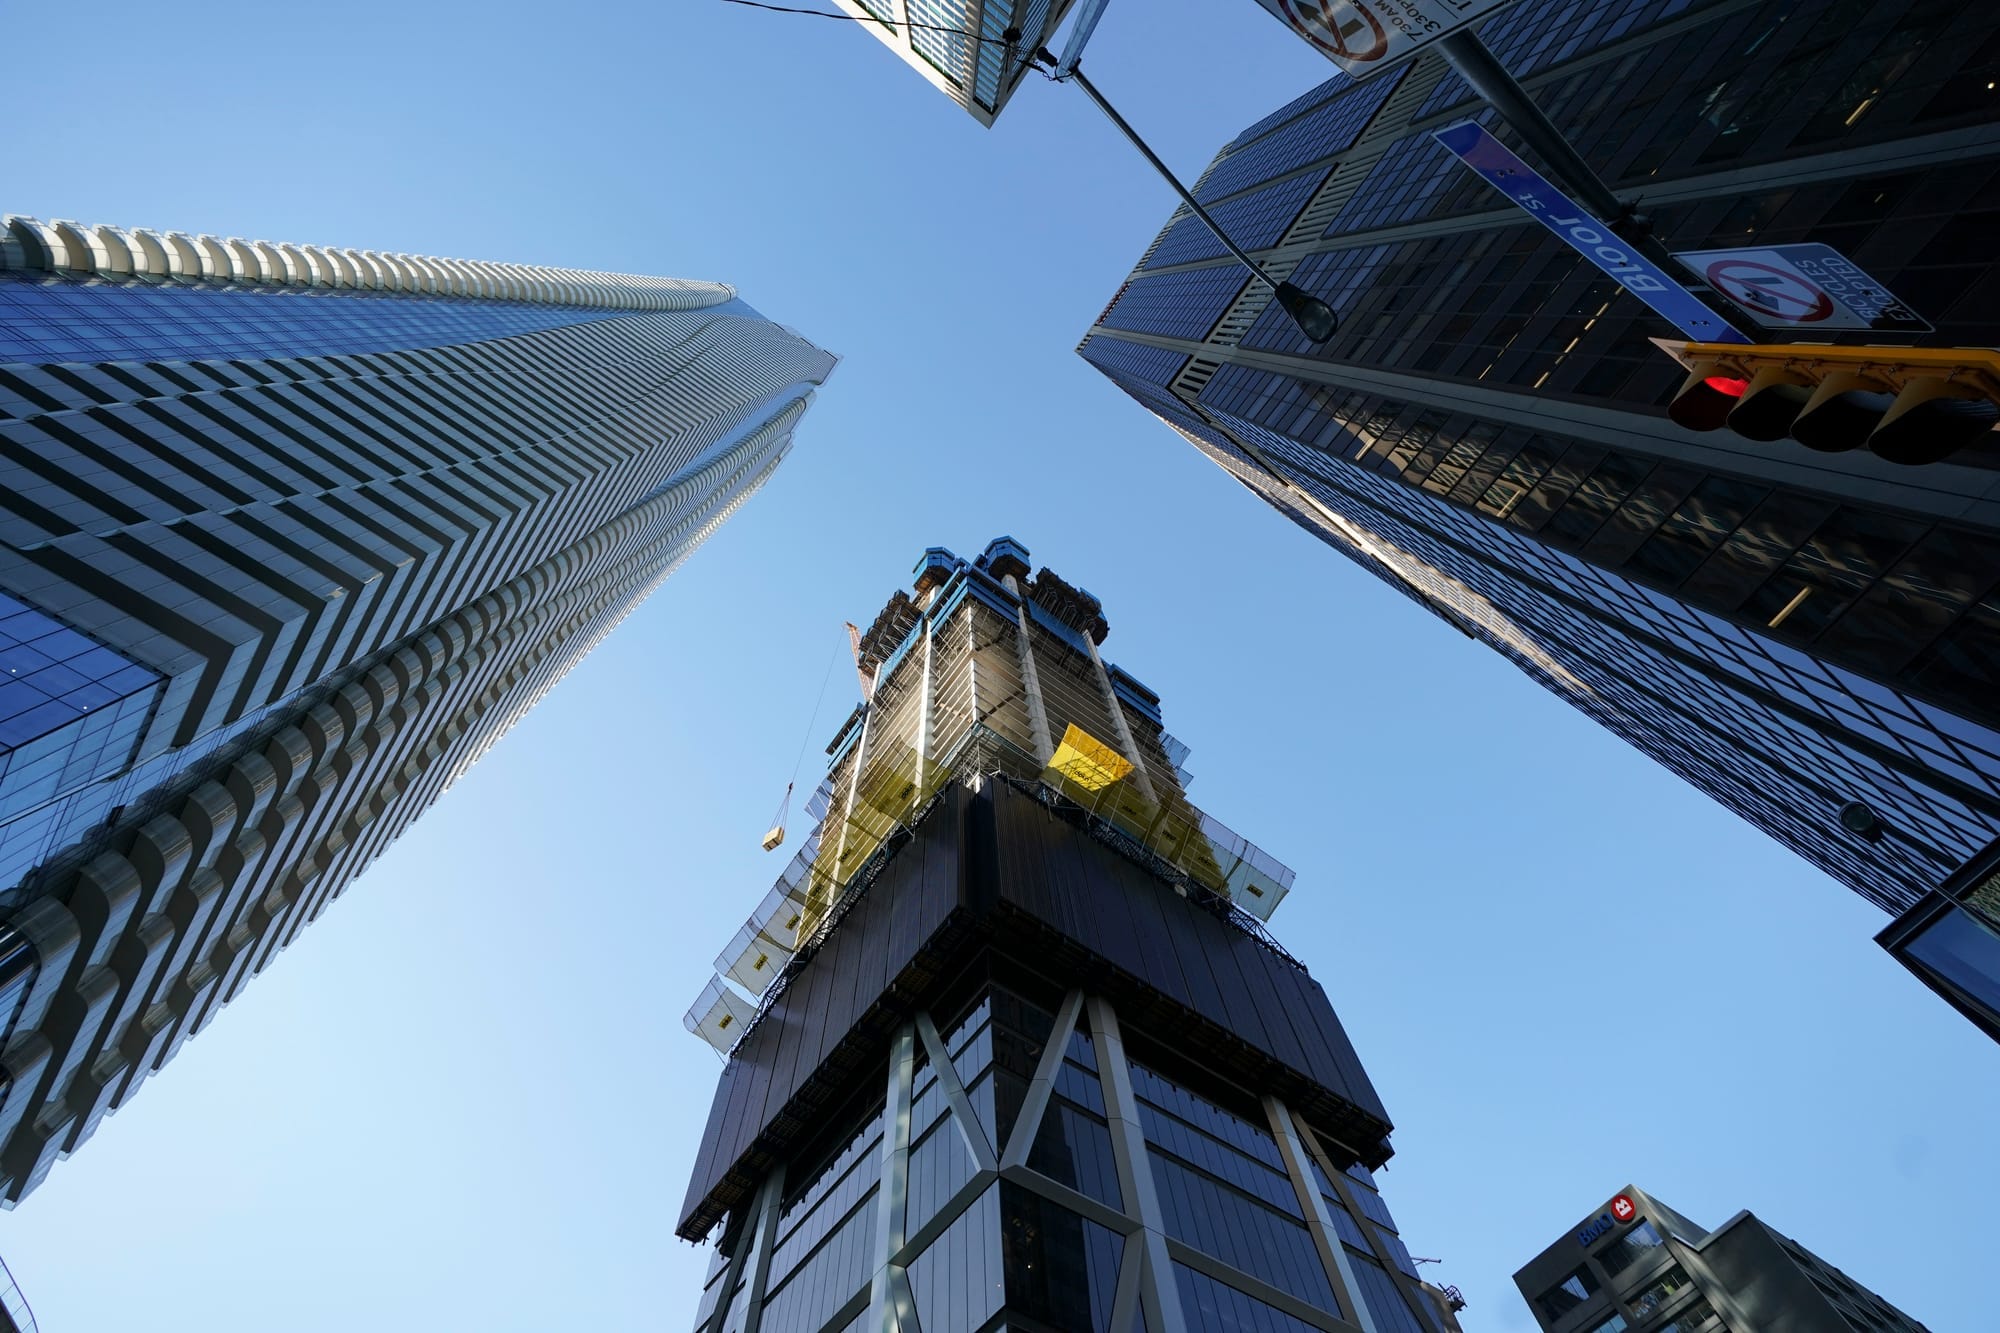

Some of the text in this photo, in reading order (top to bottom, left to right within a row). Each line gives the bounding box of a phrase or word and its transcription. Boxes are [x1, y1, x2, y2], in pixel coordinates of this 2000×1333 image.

[1396, 0, 1441, 32] 330P
[1518, 192, 1669, 292] Bloor St
[1795, 260, 1882, 319] BICYCLES
[1821, 257, 1917, 321] EXCEPTED
[1576, 1213, 1615, 1247] BMO
